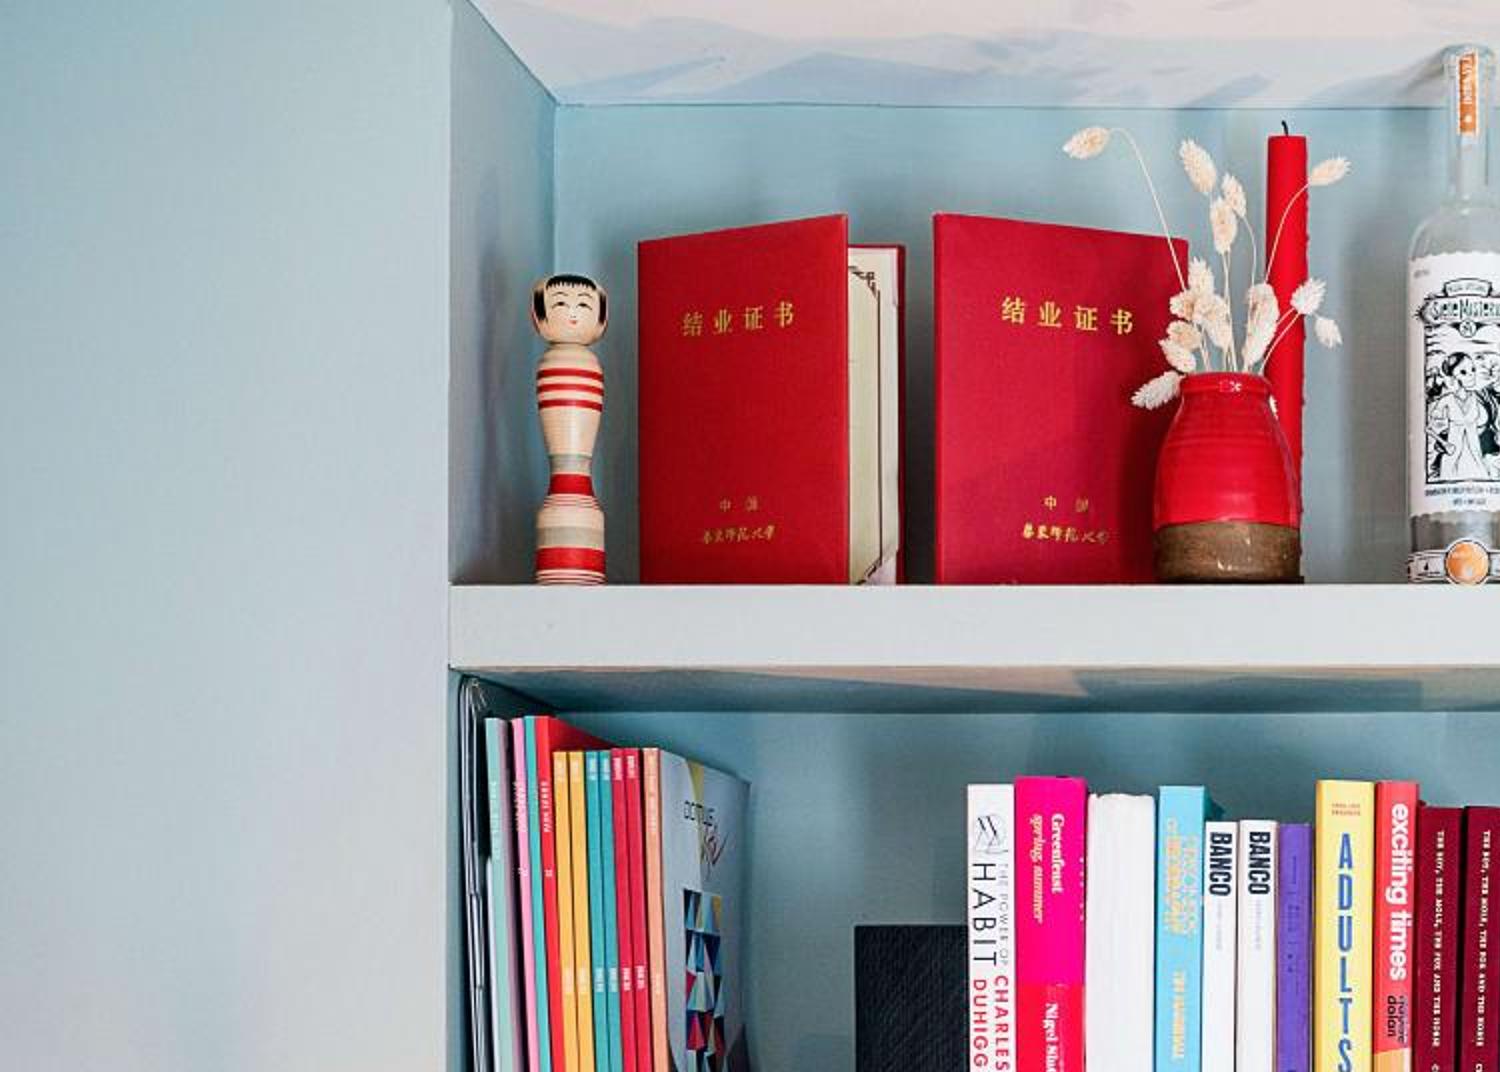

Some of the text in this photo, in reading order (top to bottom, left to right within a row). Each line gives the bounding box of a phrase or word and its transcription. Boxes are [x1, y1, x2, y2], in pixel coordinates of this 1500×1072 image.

[682, 301, 794, 337] 结业证书
[1001, 296, 1133, 335] 结业证书
[1052, 813, 1065, 894] Greenfeast
[1386, 803, 1413, 904] exciting
[1436, 831, 1445, 849] THE
[1482, 830, 1491, 849] THE
[1209, 831, 1233, 897] BANCO
[1247, 830, 1271, 896] BANCO
[1481, 876, 1490, 895] THE
[972, 862, 997, 966] HABIT
[1389, 911, 1413, 980] times
[1479, 930, 1487, 949] THE
[1433, 974, 1441, 993] AND
[1478, 973, 1486, 993] AND
[972, 979, 988, 1069] DUHIGG
[995, 975, 1010, 1072] CHARLES
[1043, 1002, 1060, 1042] Nigel
[1386, 994, 1399, 1038] dolan
[1432, 996, 1441, 1015] THE
